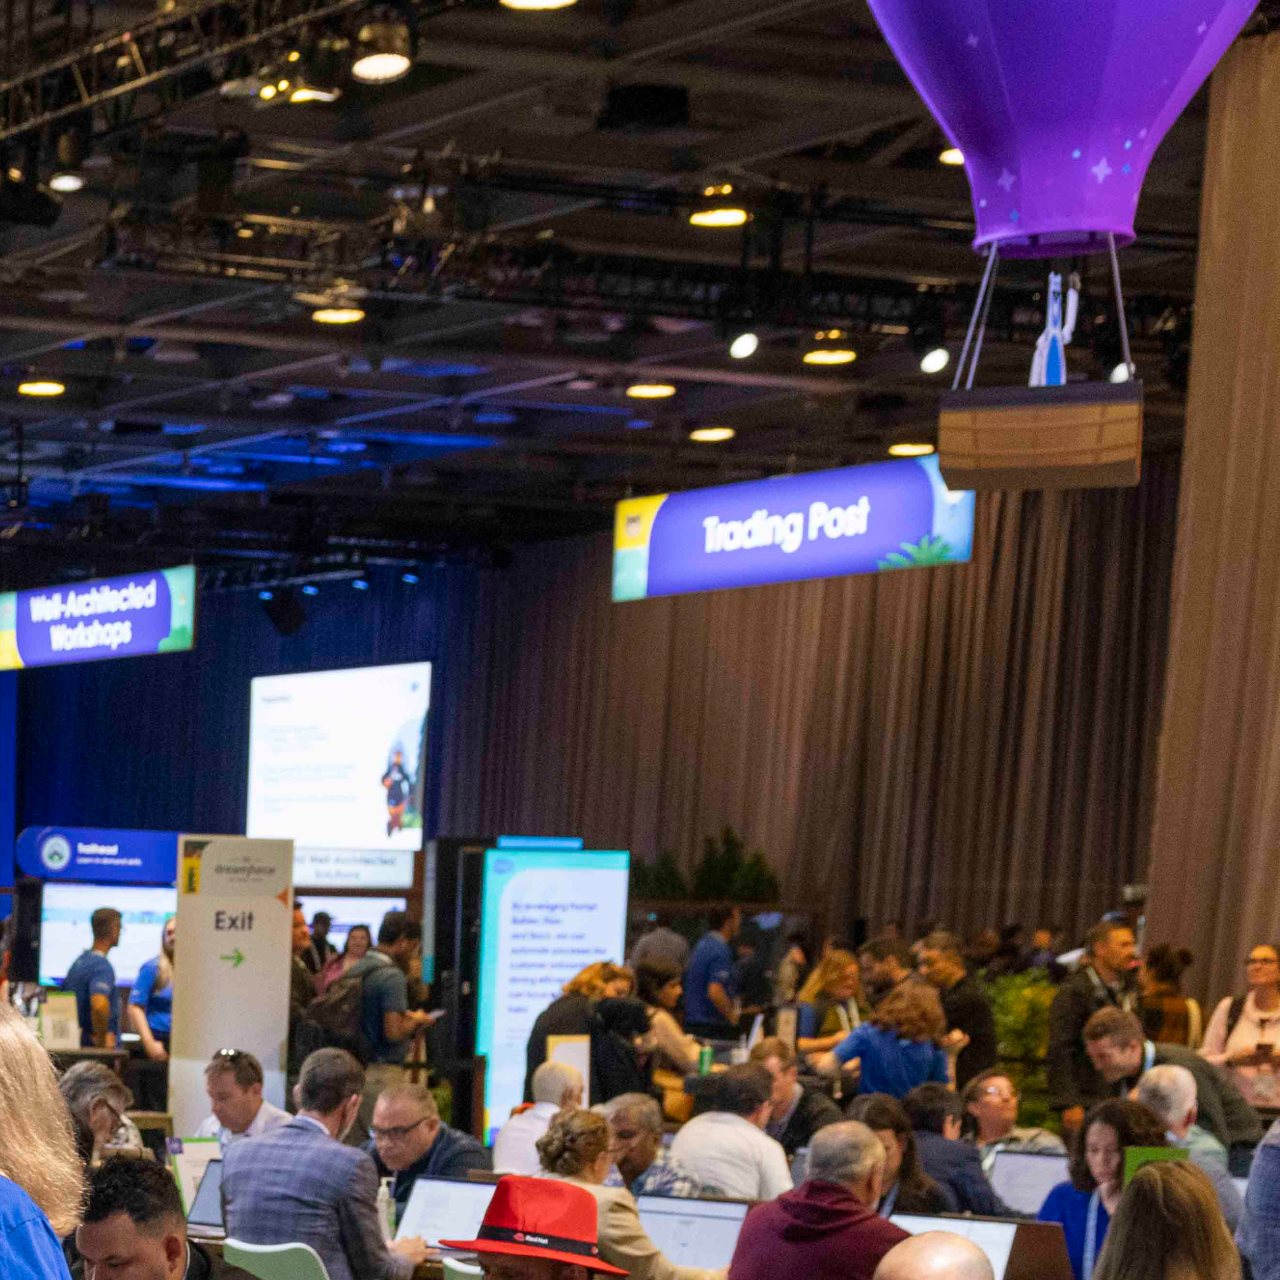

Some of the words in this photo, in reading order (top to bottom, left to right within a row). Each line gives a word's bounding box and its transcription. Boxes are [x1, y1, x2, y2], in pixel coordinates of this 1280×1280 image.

[702, 509, 804, 554] Trading
[807, 495, 872, 540] Post
[29, 578, 158, 623] Well-Architected
[49, 618, 132, 652] Workshops
[214, 910, 254, 930] Exit
